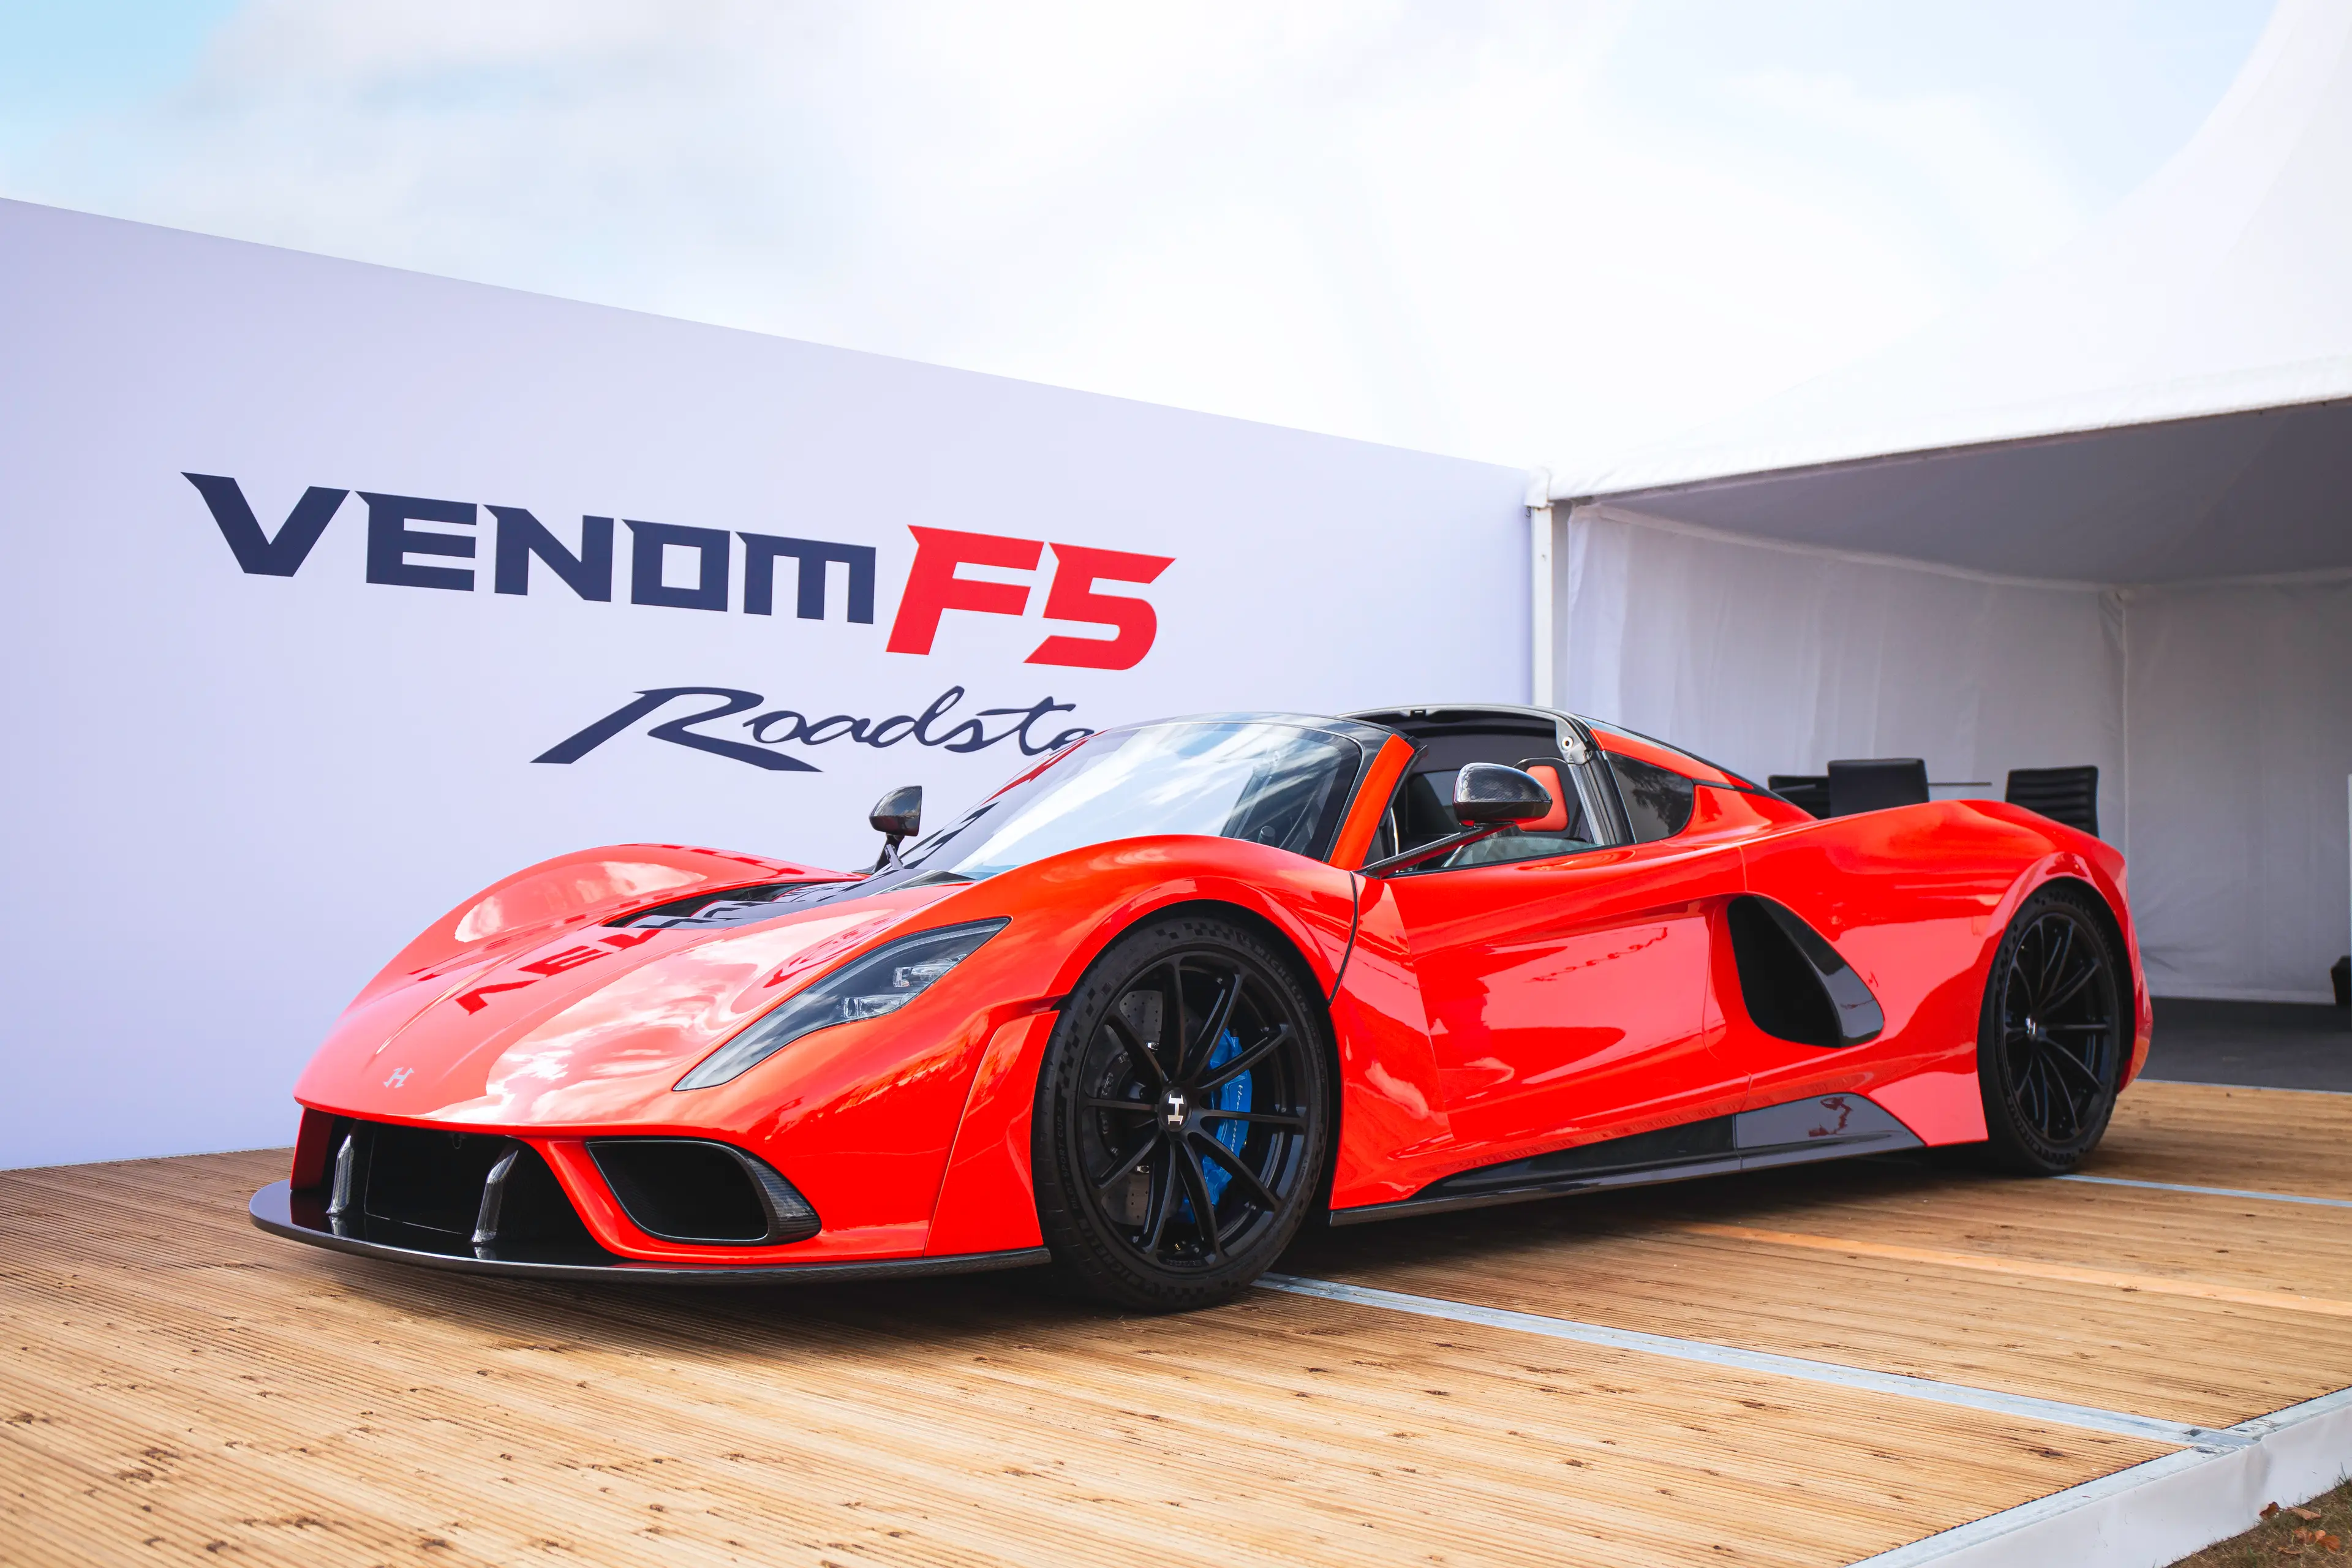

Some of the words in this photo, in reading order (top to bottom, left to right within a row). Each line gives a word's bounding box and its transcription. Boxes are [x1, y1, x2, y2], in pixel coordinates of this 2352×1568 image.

[180, 472, 876, 624] VENOM
[886, 525, 1177, 671] F5
[529, 685, 1095, 772] Roadste
[1253, 944, 1308, 1012] MICHELIN
[1057, 1115, 1066, 1138] CUP
[1230, 1084, 1243, 1152] Henessey
[1058, 1140, 1070, 1178] SPORT
[1065, 1180, 1079, 1210] PILOT
